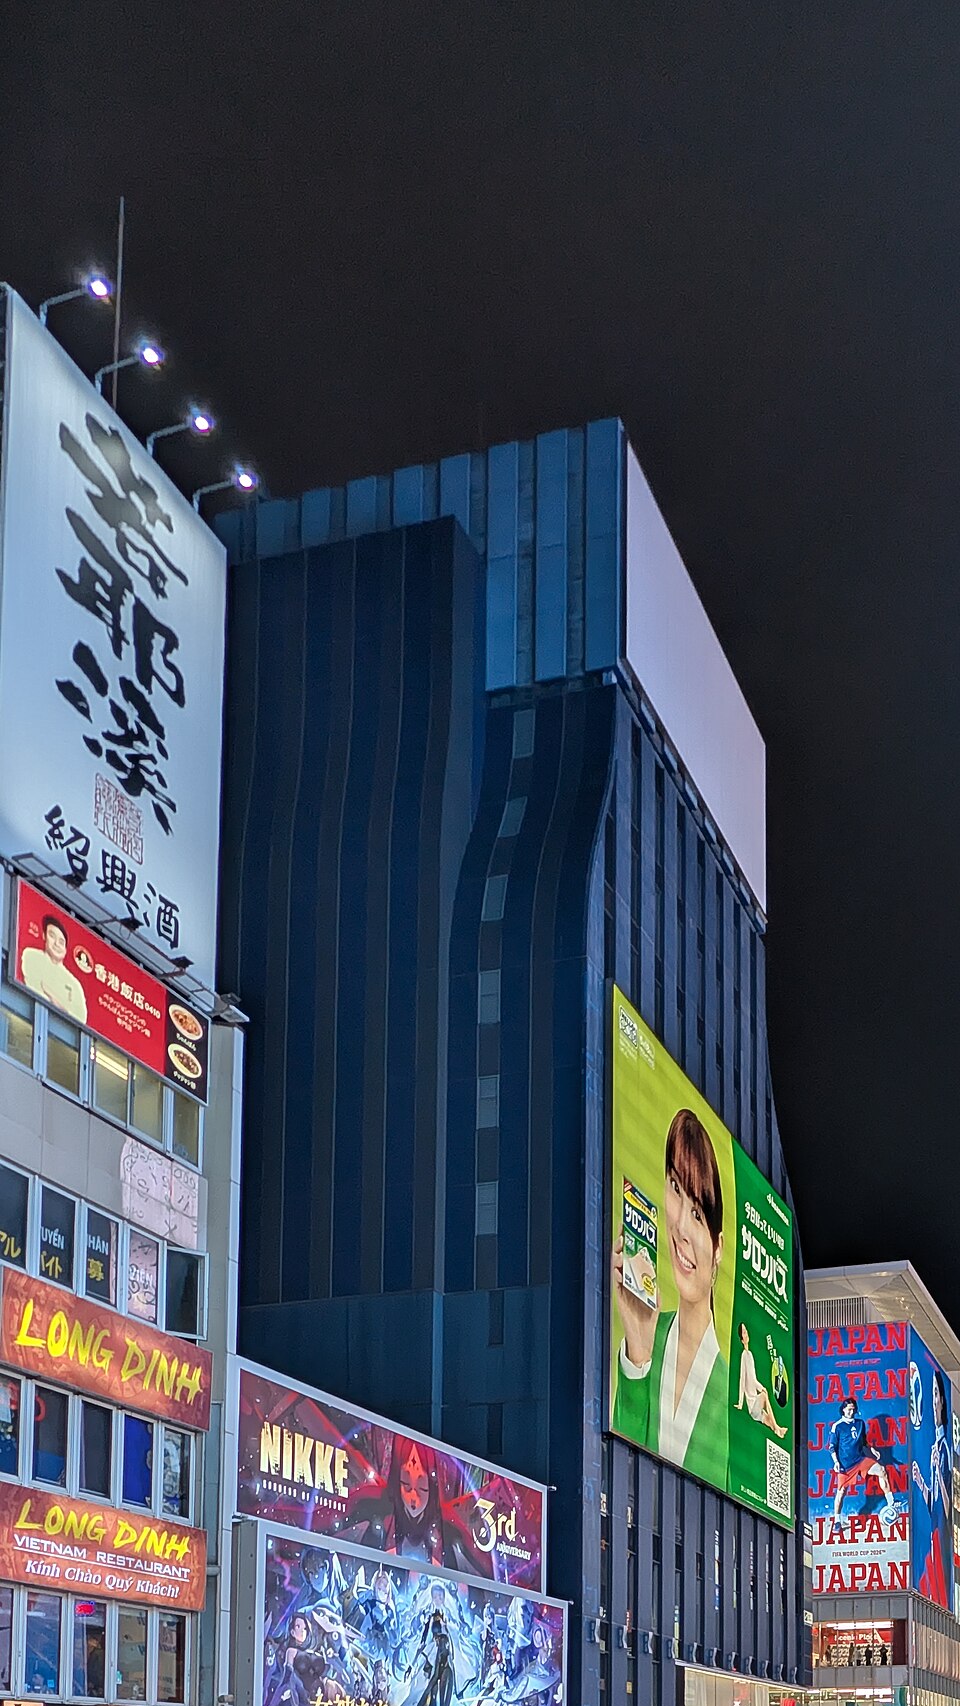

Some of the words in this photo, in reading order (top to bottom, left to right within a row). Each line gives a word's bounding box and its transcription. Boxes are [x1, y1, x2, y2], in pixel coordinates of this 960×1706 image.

[45, 804, 181, 950] 紹興酒
[94, 963, 145, 1010] 香港飯店
[40, 1226, 65, 1250] UYỂN
[87, 1233, 109, 1256] HÂN
[624, 1203, 656, 1247] サロンパス
[741, 1224, 789, 1304] サロンパス
[15, 1299, 113, 1376] LONG
[121, 1338, 203, 1404] DINH
[808, 1323, 907, 1357] JAPAN
[808, 1369, 908, 1404] JAPAN
[808, 1417, 907, 1450] JAN
[260, 1422, 349, 1498] NIKKE
[14, 1499, 107, 1544] LONG
[112, 1519, 191, 1561] DINH
[473, 1498, 518, 1553] 3rd
[812, 1513, 909, 1545] JAPAN
[14, 1535, 87, 1559] VIETNAM
[96, 1552, 190, 1578] RESTAURANT
[496, 1543, 532, 1561] ANNIVERSARY
[25, 1559, 60, 1578] Kính
[64, 1566, 102, 1585] Chào
[105, 1573, 134, 1592] Quý
[136, 1577, 180, 1598] Khách!
[812, 1561, 909, 1593] JAPAN
